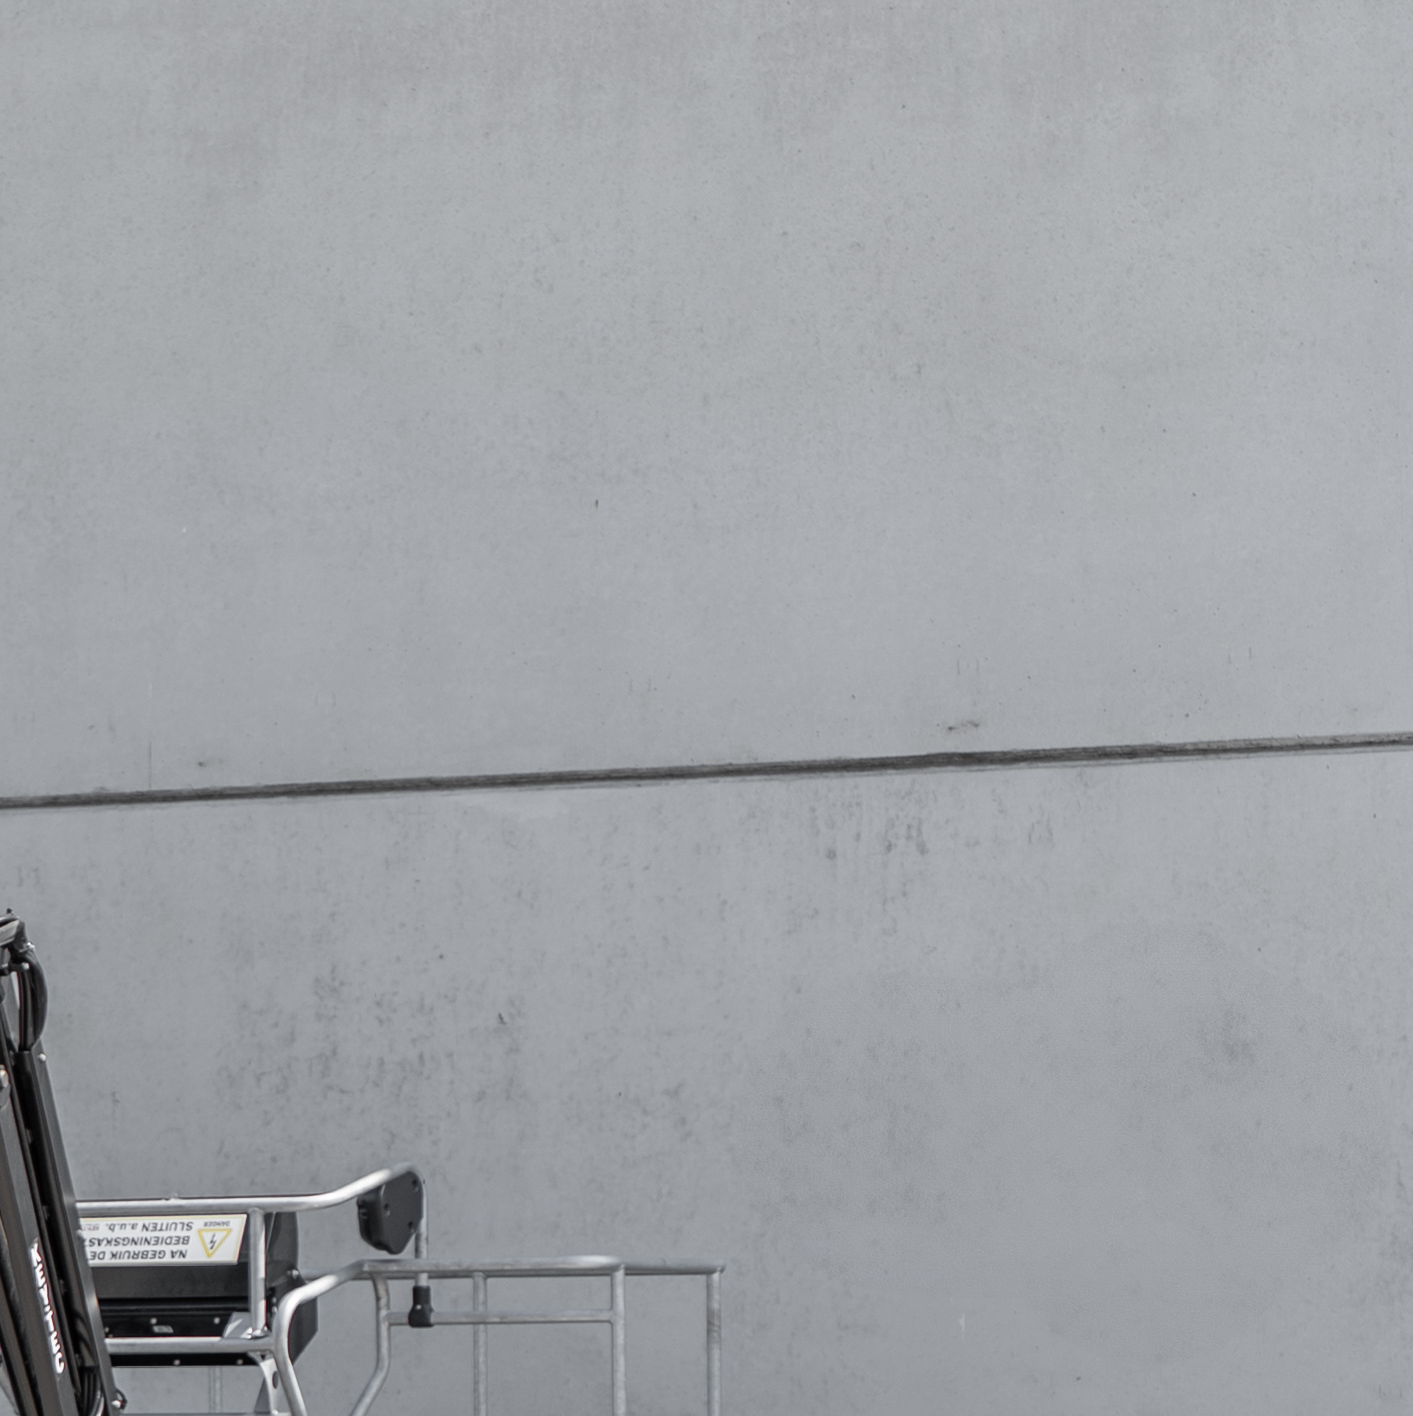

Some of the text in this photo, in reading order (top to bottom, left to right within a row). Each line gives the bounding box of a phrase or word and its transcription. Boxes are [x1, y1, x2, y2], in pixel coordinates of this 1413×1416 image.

[105, 1222, 139, 1231] a.u.b.
[141, 1221, 194, 1232] SLUITEN
[89, 1249, 188, 1260] NA GEBRUIK DE
[30, 1242, 66, 1374] KEY-TEC
